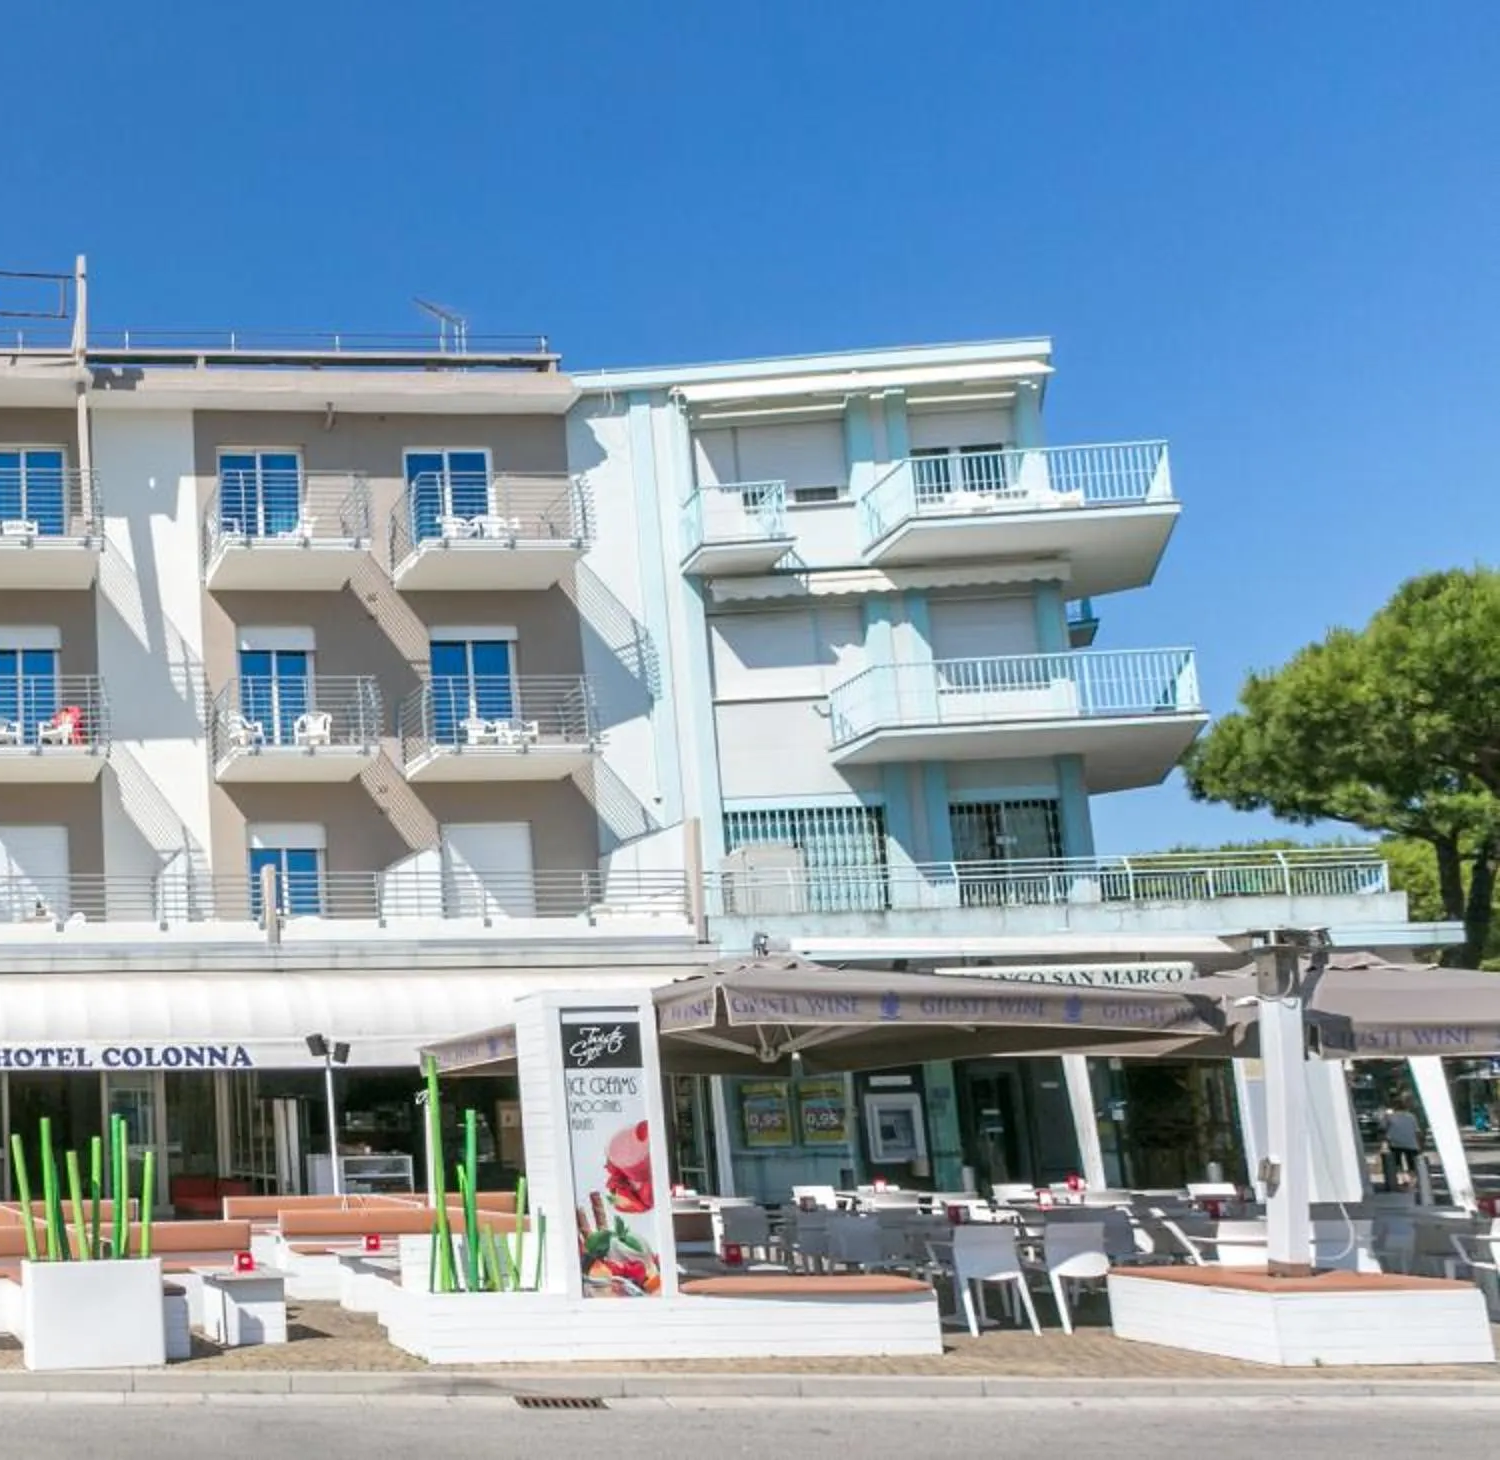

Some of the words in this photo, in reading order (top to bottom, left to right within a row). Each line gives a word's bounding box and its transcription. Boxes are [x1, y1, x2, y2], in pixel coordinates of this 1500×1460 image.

[1052, 971, 1093, 985] SAN
[1102, 968, 1183, 984] MARCO
[101, 1045, 253, 1068] COLONNA
[567, 1076, 586, 1097] ICE
[589, 1075, 638, 1096] CREAMS
